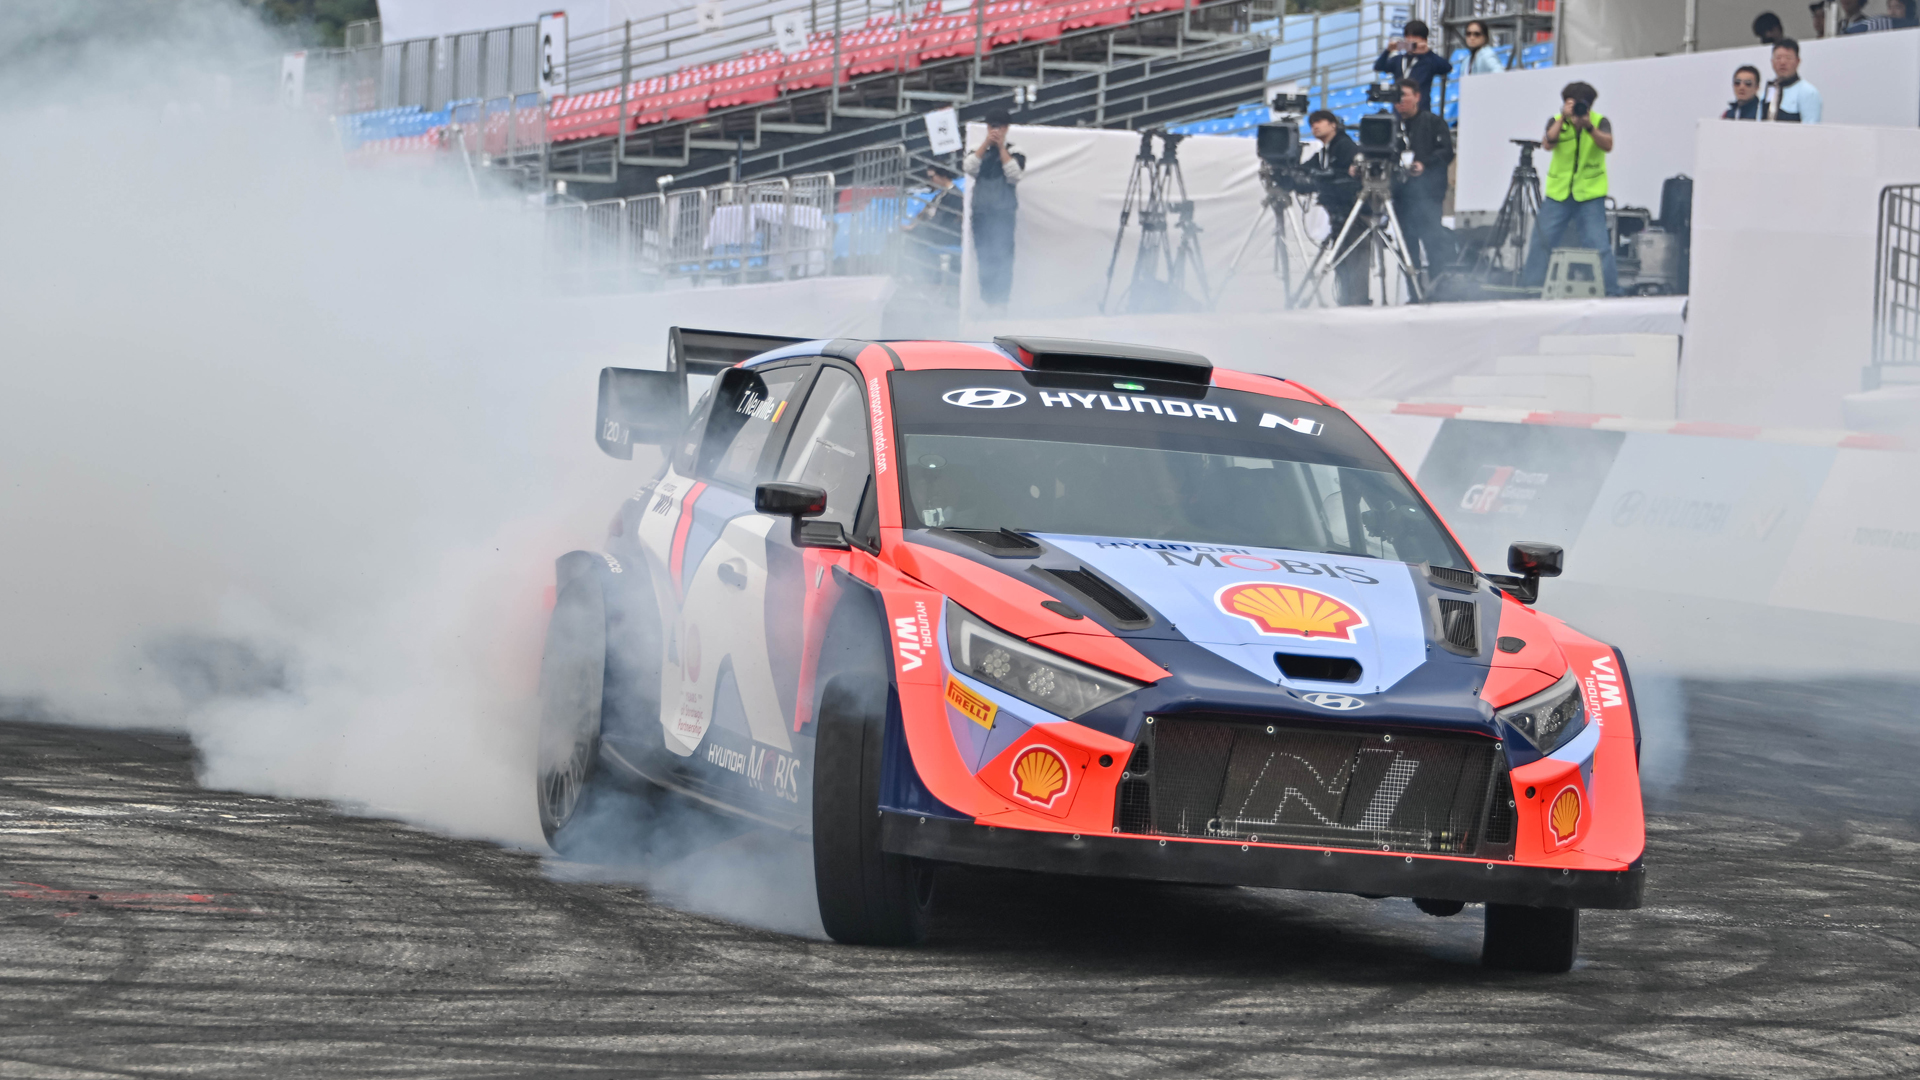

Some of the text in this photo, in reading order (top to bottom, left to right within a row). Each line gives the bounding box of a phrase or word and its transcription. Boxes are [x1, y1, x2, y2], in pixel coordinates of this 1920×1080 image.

[870, 377, 888, 475] motorsport.hyundai.com
[1039, 391, 1237, 423] HYUNDAI
[603, 418, 620, 442] i20
[1461, 484, 1501, 511] GR
[1095, 542, 1252, 556] HYUNDAI
[1155, 551, 1380, 585] MOBIS
[895, 617, 926, 672] WIA
[915, 601, 933, 648] HYUNDAI
[948, 680, 992, 723] PIRELLI
[1584, 677, 1604, 727] HYUNDAI
[1591, 656, 1623, 708] WIA
[677, 718, 702, 736] Partnership
[707, 743, 801, 804] HYUNDAI MOBIS
